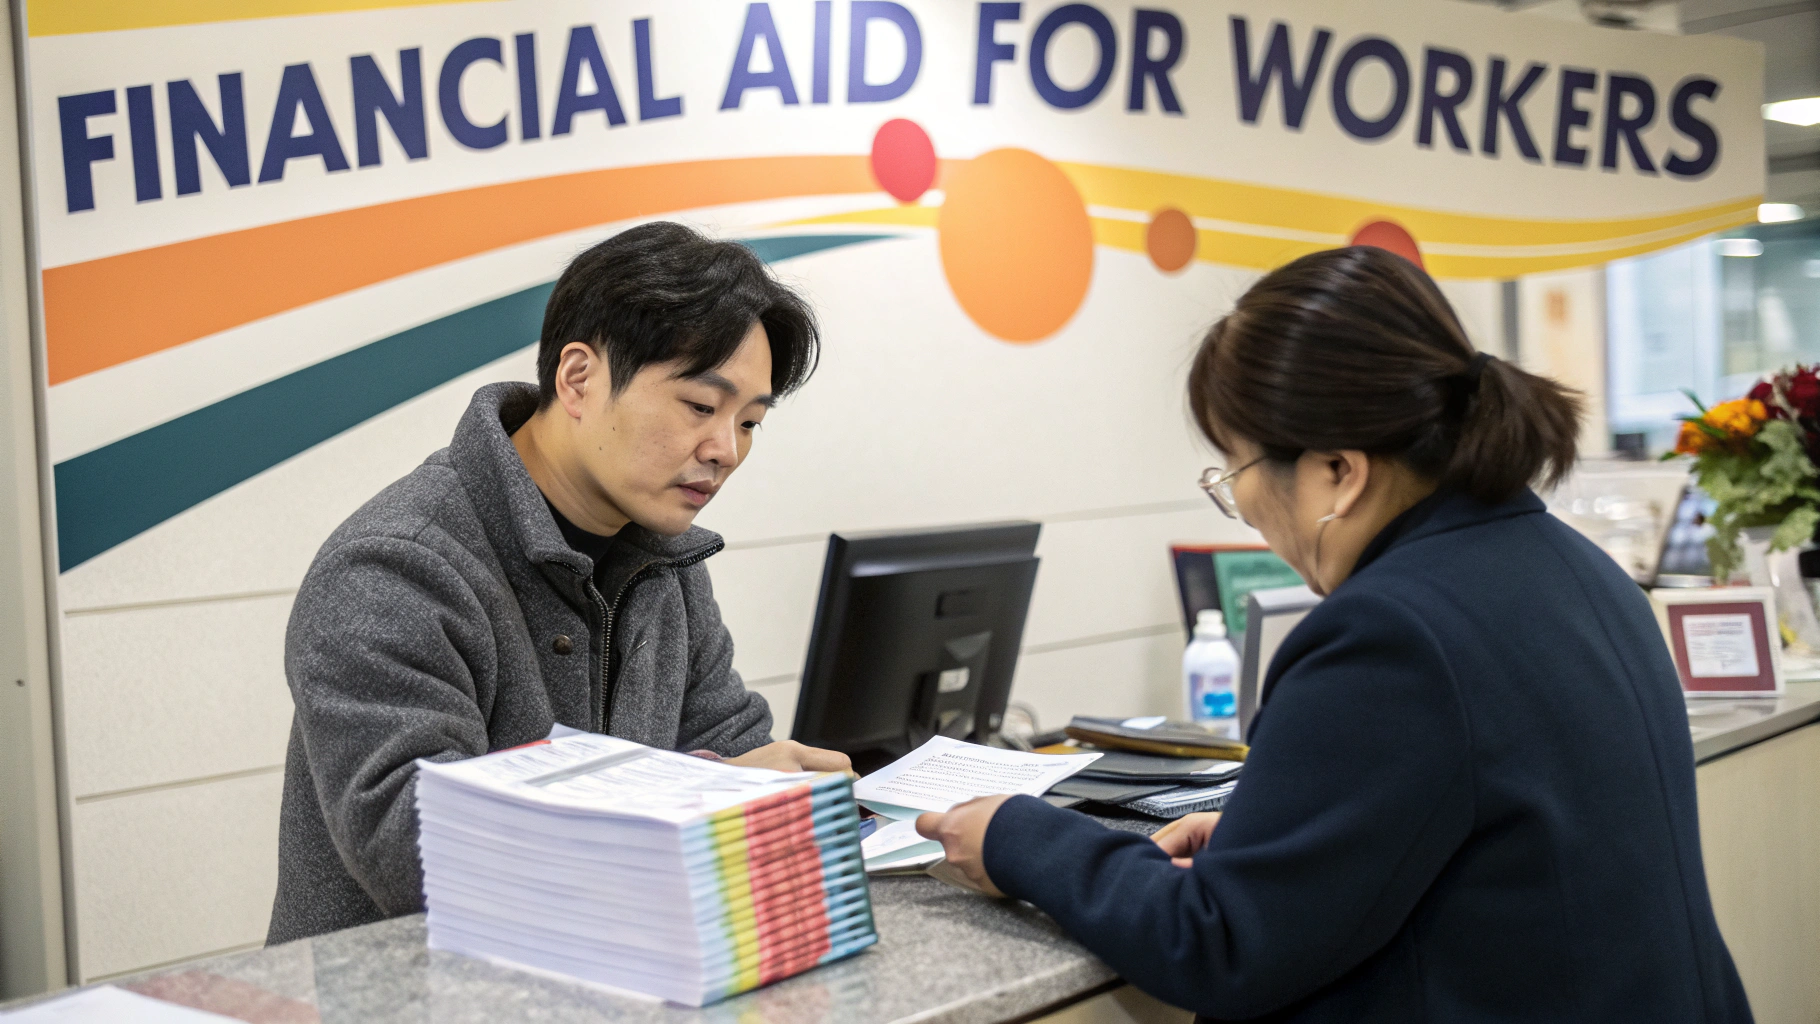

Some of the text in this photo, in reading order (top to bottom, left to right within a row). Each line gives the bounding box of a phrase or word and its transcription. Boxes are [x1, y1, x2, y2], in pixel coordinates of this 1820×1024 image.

[57, 1, 1721, 213] FINANCIAL AID FOR WORKERS
